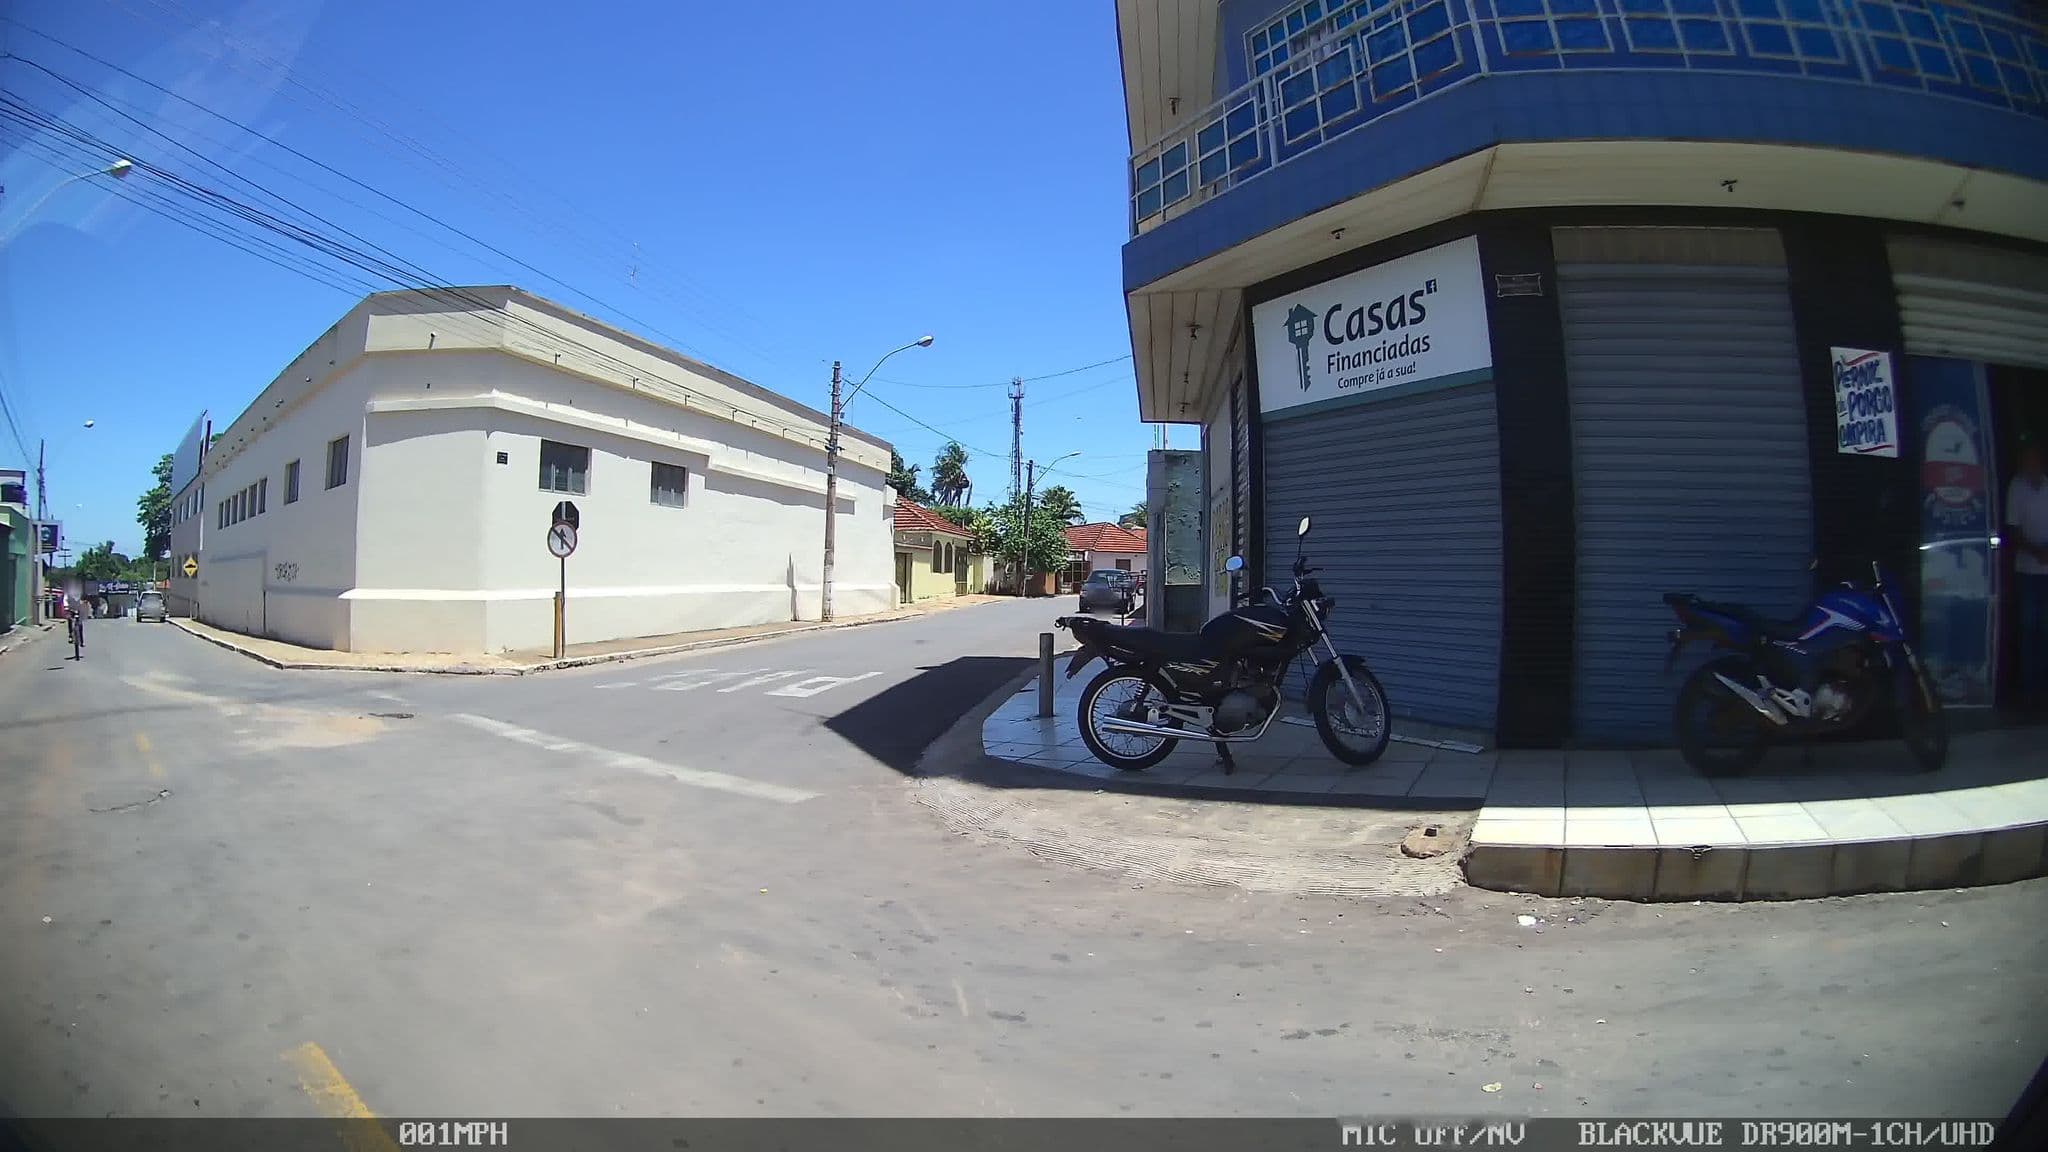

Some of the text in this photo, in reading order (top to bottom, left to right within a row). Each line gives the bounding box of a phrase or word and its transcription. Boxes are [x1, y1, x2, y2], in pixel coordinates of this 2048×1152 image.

[1323, 289, 1427, 346] Casas
[1327, 333, 1431, 375] Financiadas
[1338, 361, 1416, 389] Compre já a sua!
